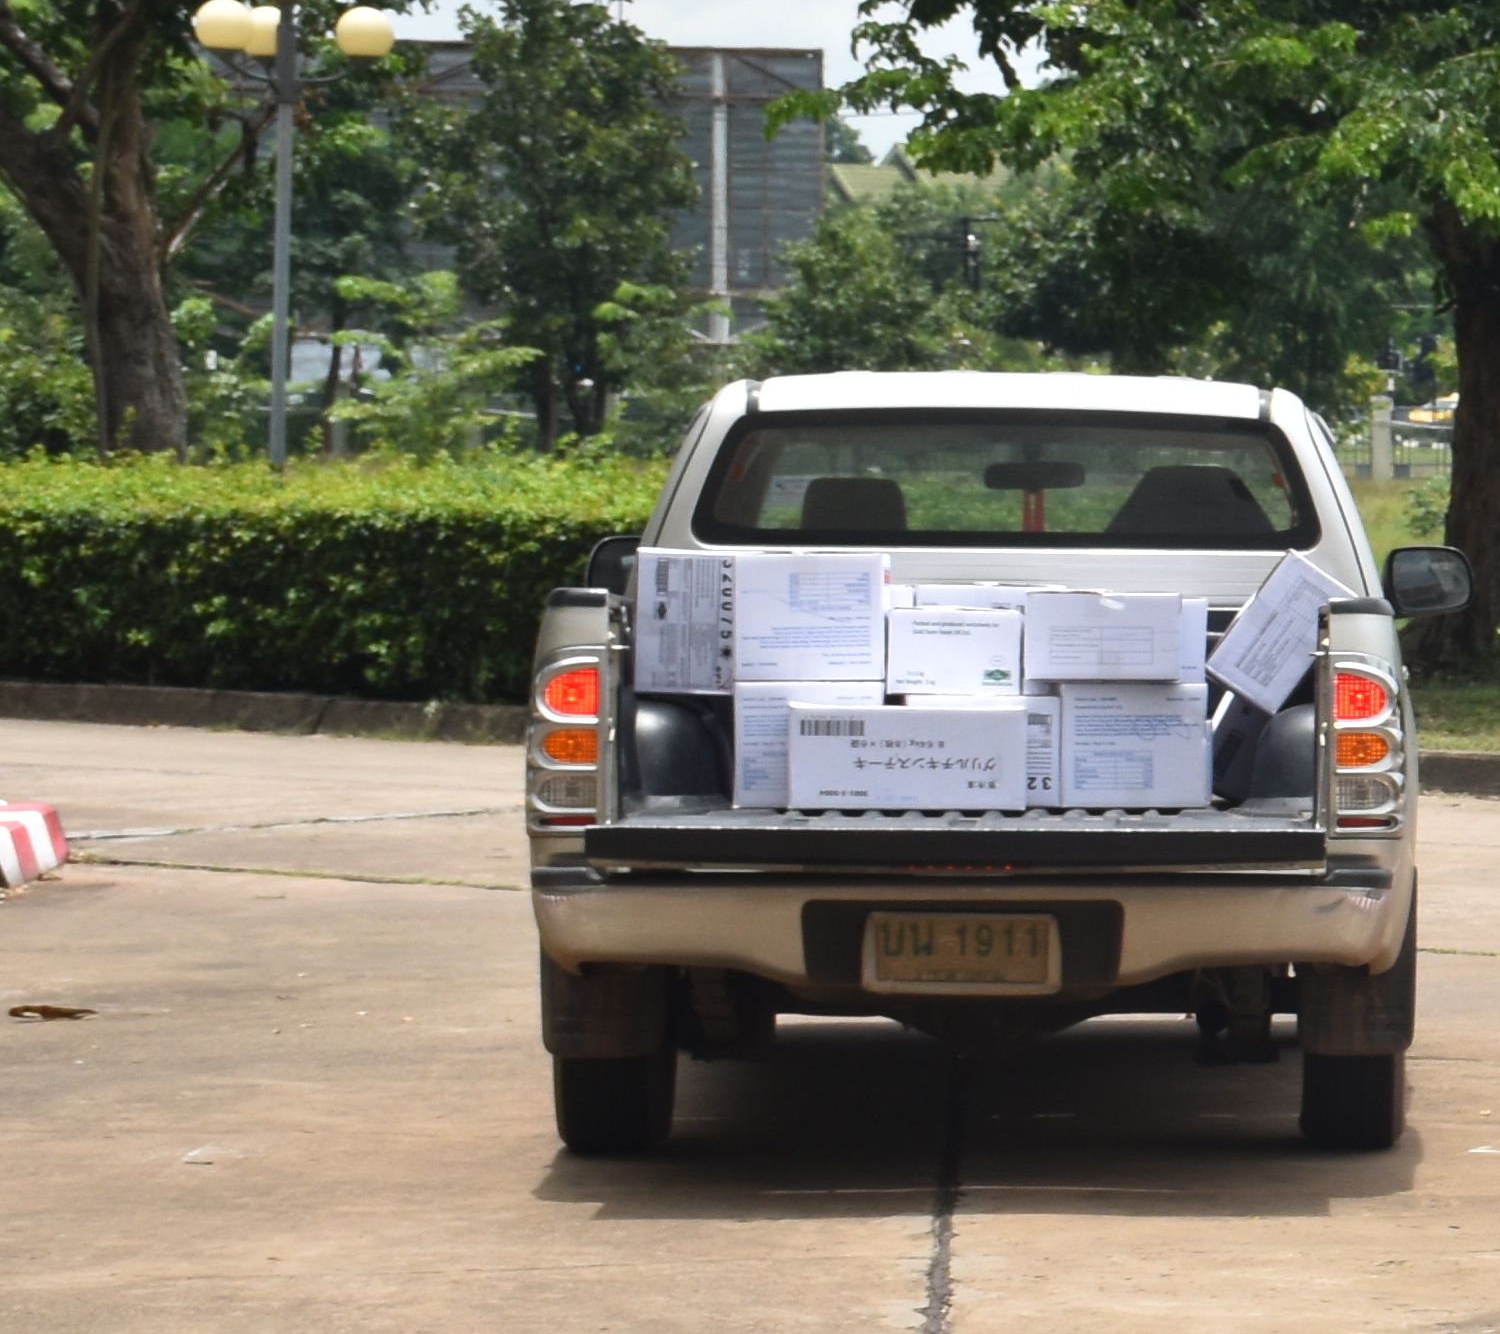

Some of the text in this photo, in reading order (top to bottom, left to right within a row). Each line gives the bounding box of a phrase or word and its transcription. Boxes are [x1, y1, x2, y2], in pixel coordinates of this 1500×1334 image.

[853, 757, 996, 771] グリルチキンステーキ
[956, 923, 1038, 957] 1911
